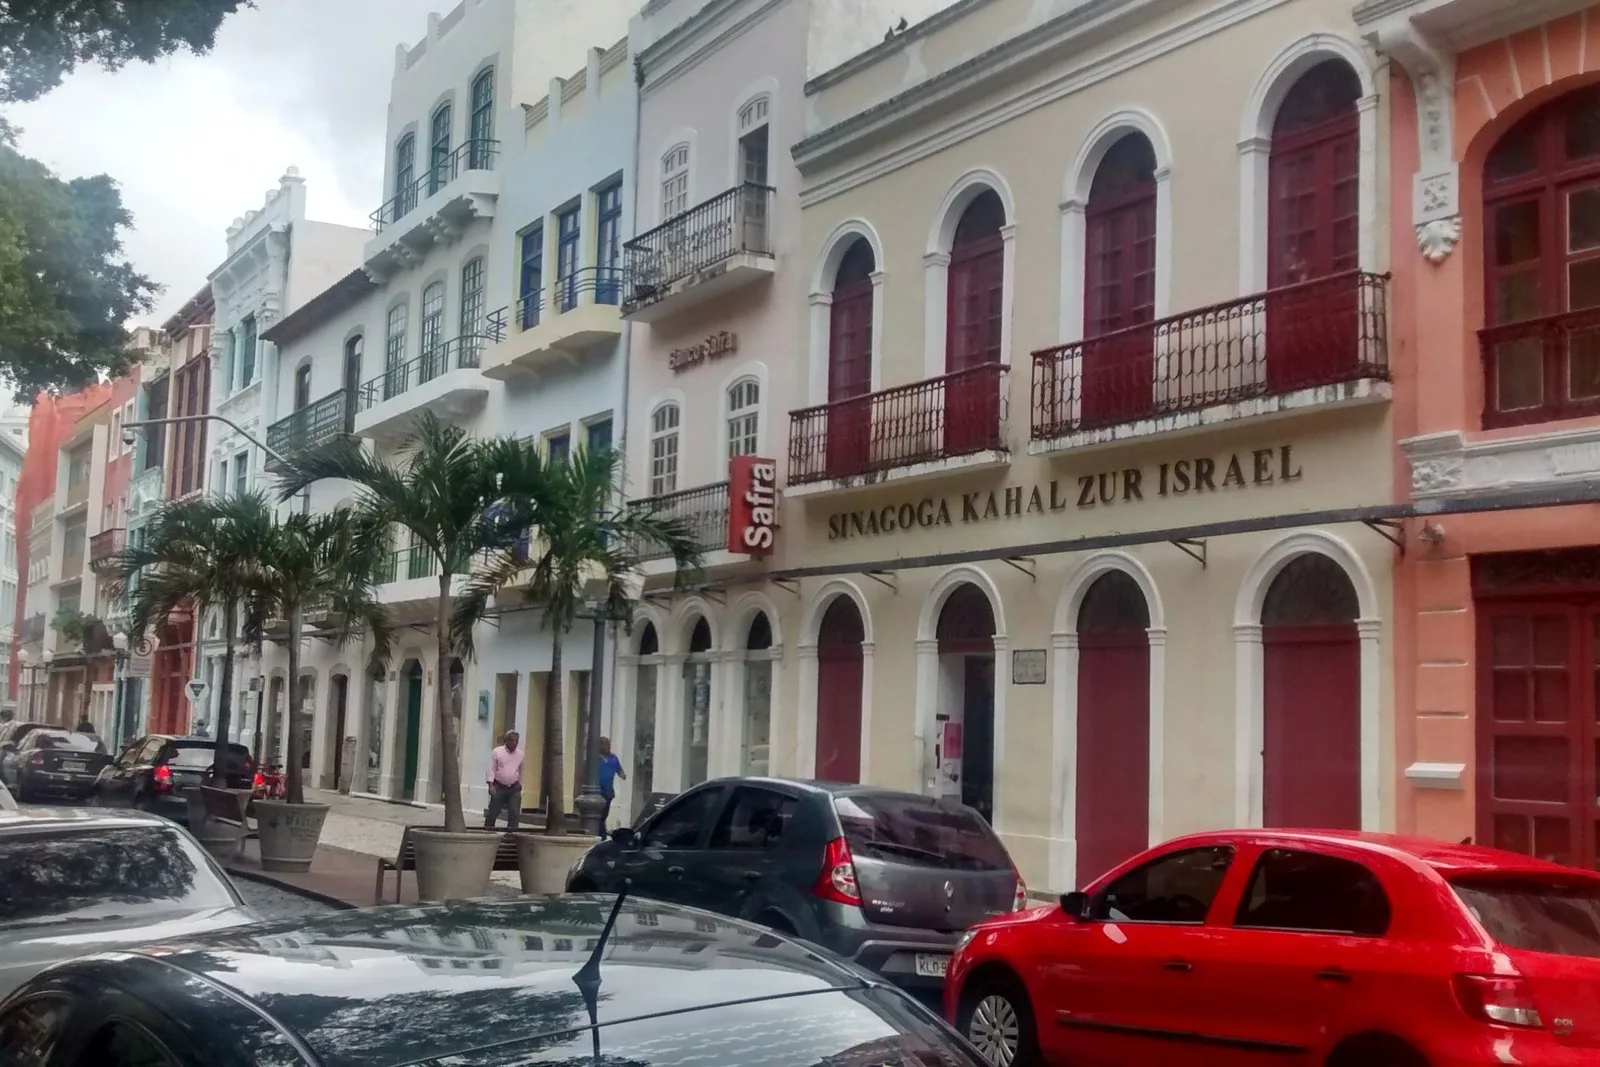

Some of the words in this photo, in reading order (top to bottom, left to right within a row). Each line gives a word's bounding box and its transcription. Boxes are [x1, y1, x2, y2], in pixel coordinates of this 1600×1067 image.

[744, 462, 775, 549] Safra
[828, 498, 951, 540] SINAGOGA
[961, 480, 1067, 522] KAHAL
[1076, 468, 1143, 507] ZUR
[1158, 445, 1302, 497] ISRAEL
